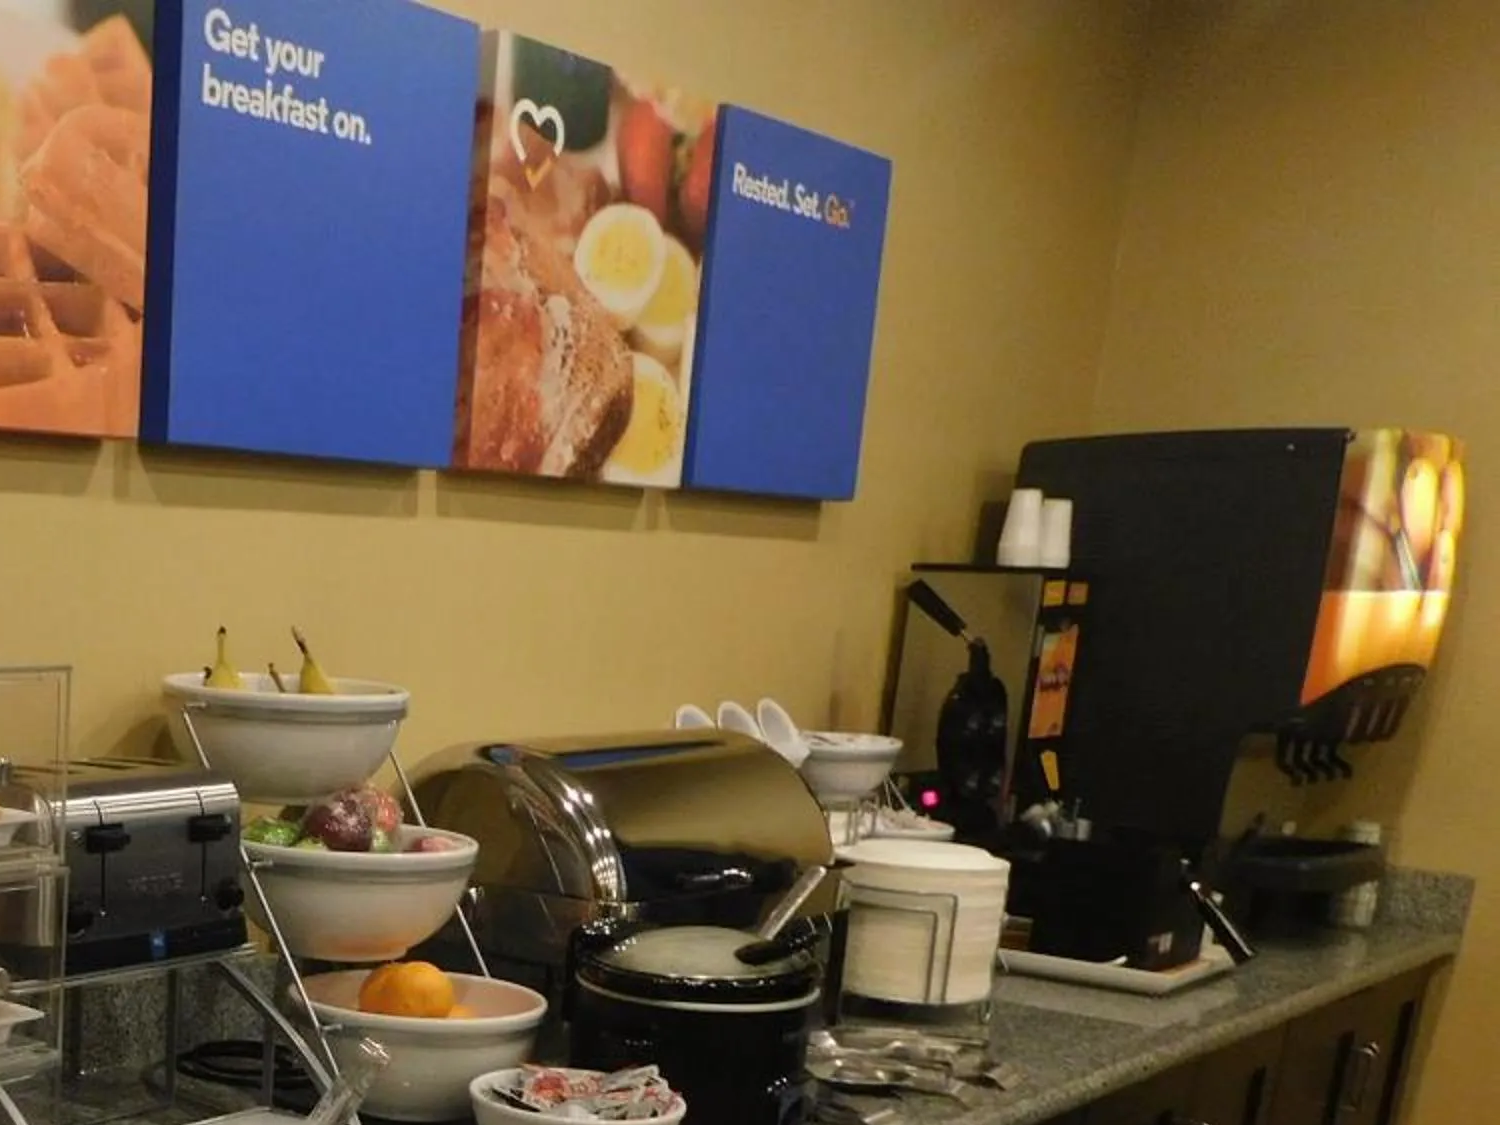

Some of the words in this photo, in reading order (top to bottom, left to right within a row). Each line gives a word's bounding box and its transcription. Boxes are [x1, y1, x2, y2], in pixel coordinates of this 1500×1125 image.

[204, 8, 259, 62] Get
[265, 37, 325, 78] your
[202, 63, 329, 134] breakfast
[332, 110, 372, 145] on.
[732, 162, 791, 212] Rested.
[793, 183, 822, 221] Set.
[824, 193, 850, 229] Go.
